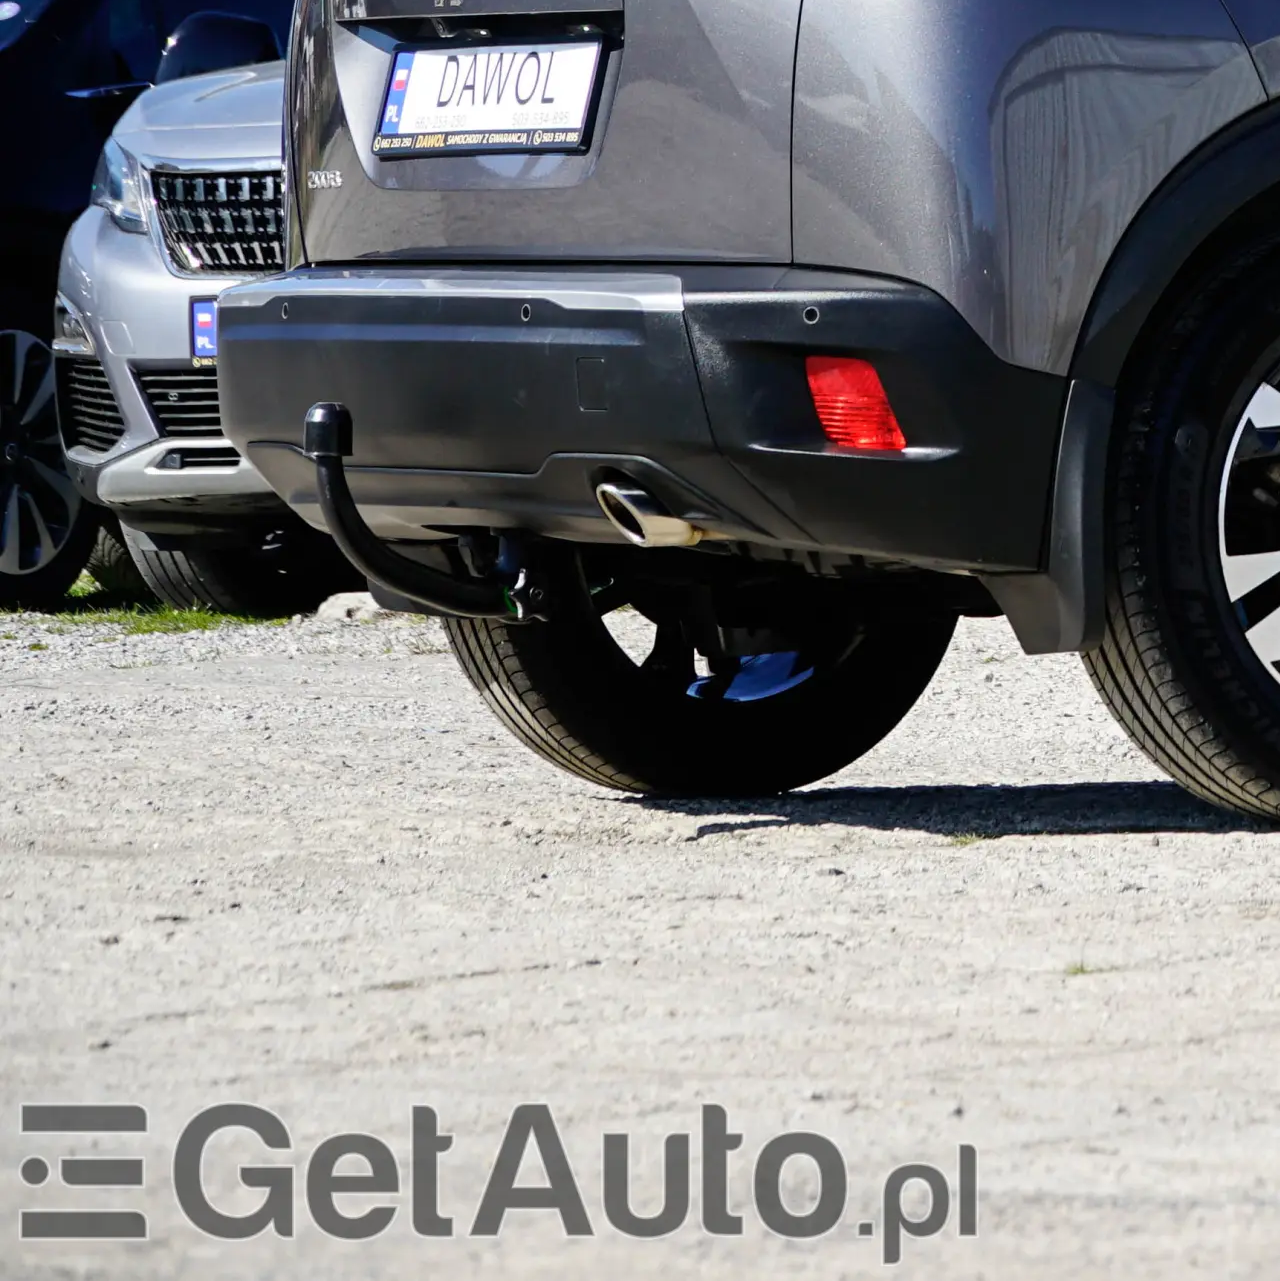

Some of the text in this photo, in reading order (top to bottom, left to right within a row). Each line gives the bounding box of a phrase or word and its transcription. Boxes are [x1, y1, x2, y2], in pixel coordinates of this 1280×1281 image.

[437, 50, 555, 108] DAWOL
[385, 105, 399, 123] PL
[415, 134, 445, 148] DAWOL
[446, 133, 483, 145] SAMOCHODY
[197, 334, 215, 349] PL
